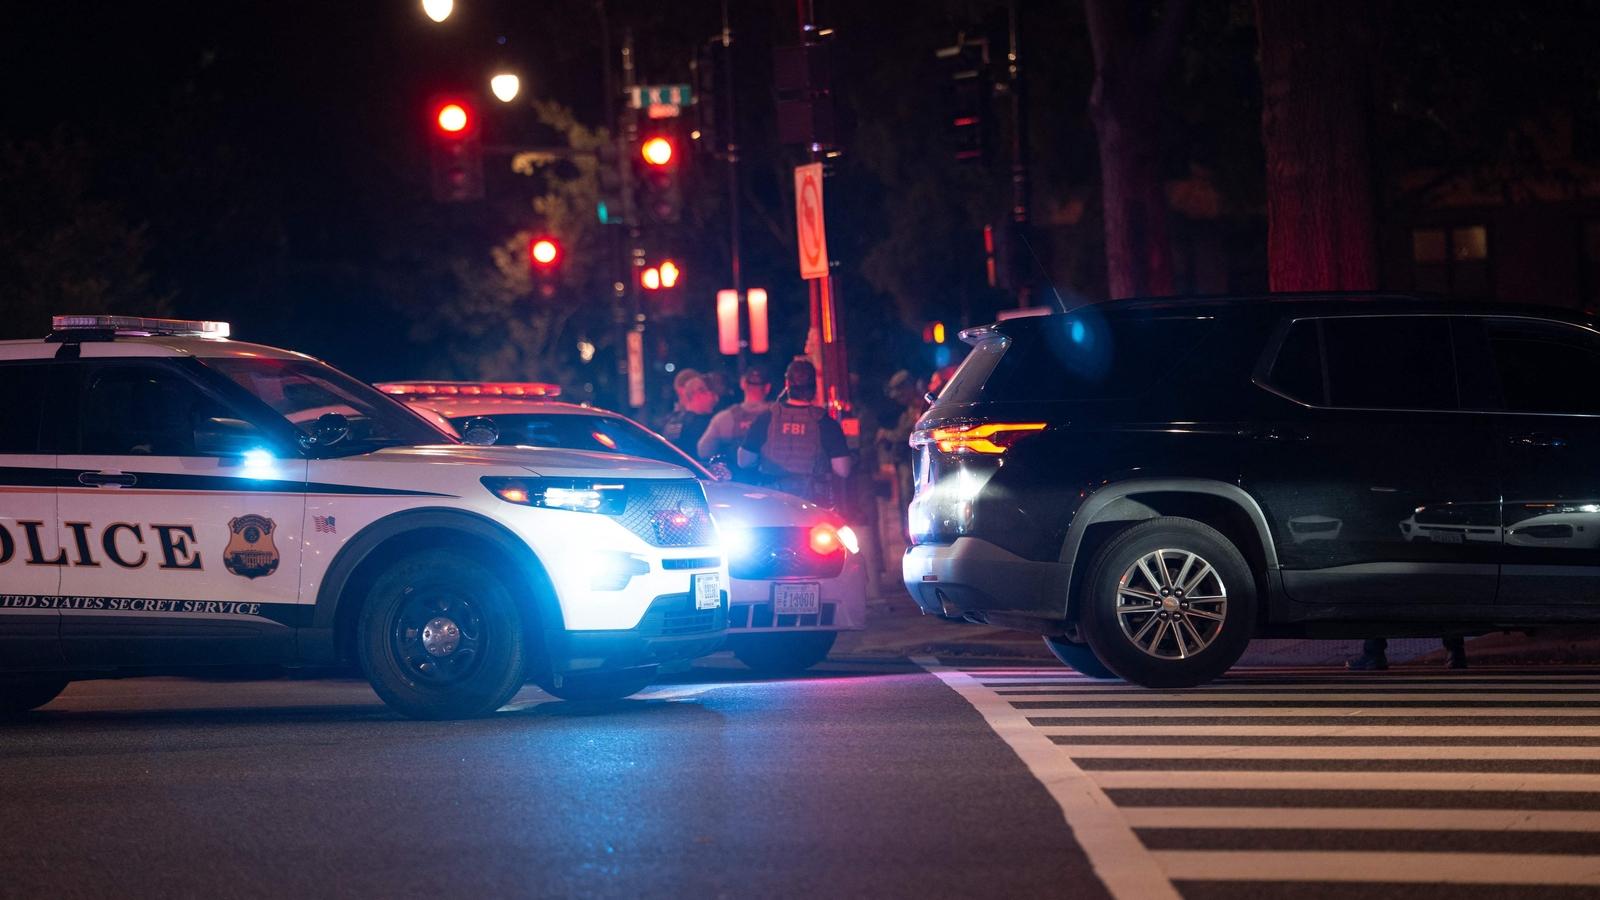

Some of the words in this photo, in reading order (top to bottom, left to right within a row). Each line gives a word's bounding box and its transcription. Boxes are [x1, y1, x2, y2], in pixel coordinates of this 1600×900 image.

[783, 422, 805, 435] FBI
[0, 595, 37, 608] TED
[40, 596, 105, 609] STATES
[108, 598, 179, 612] SECRET
[182, 601, 261, 615] SERVICE
